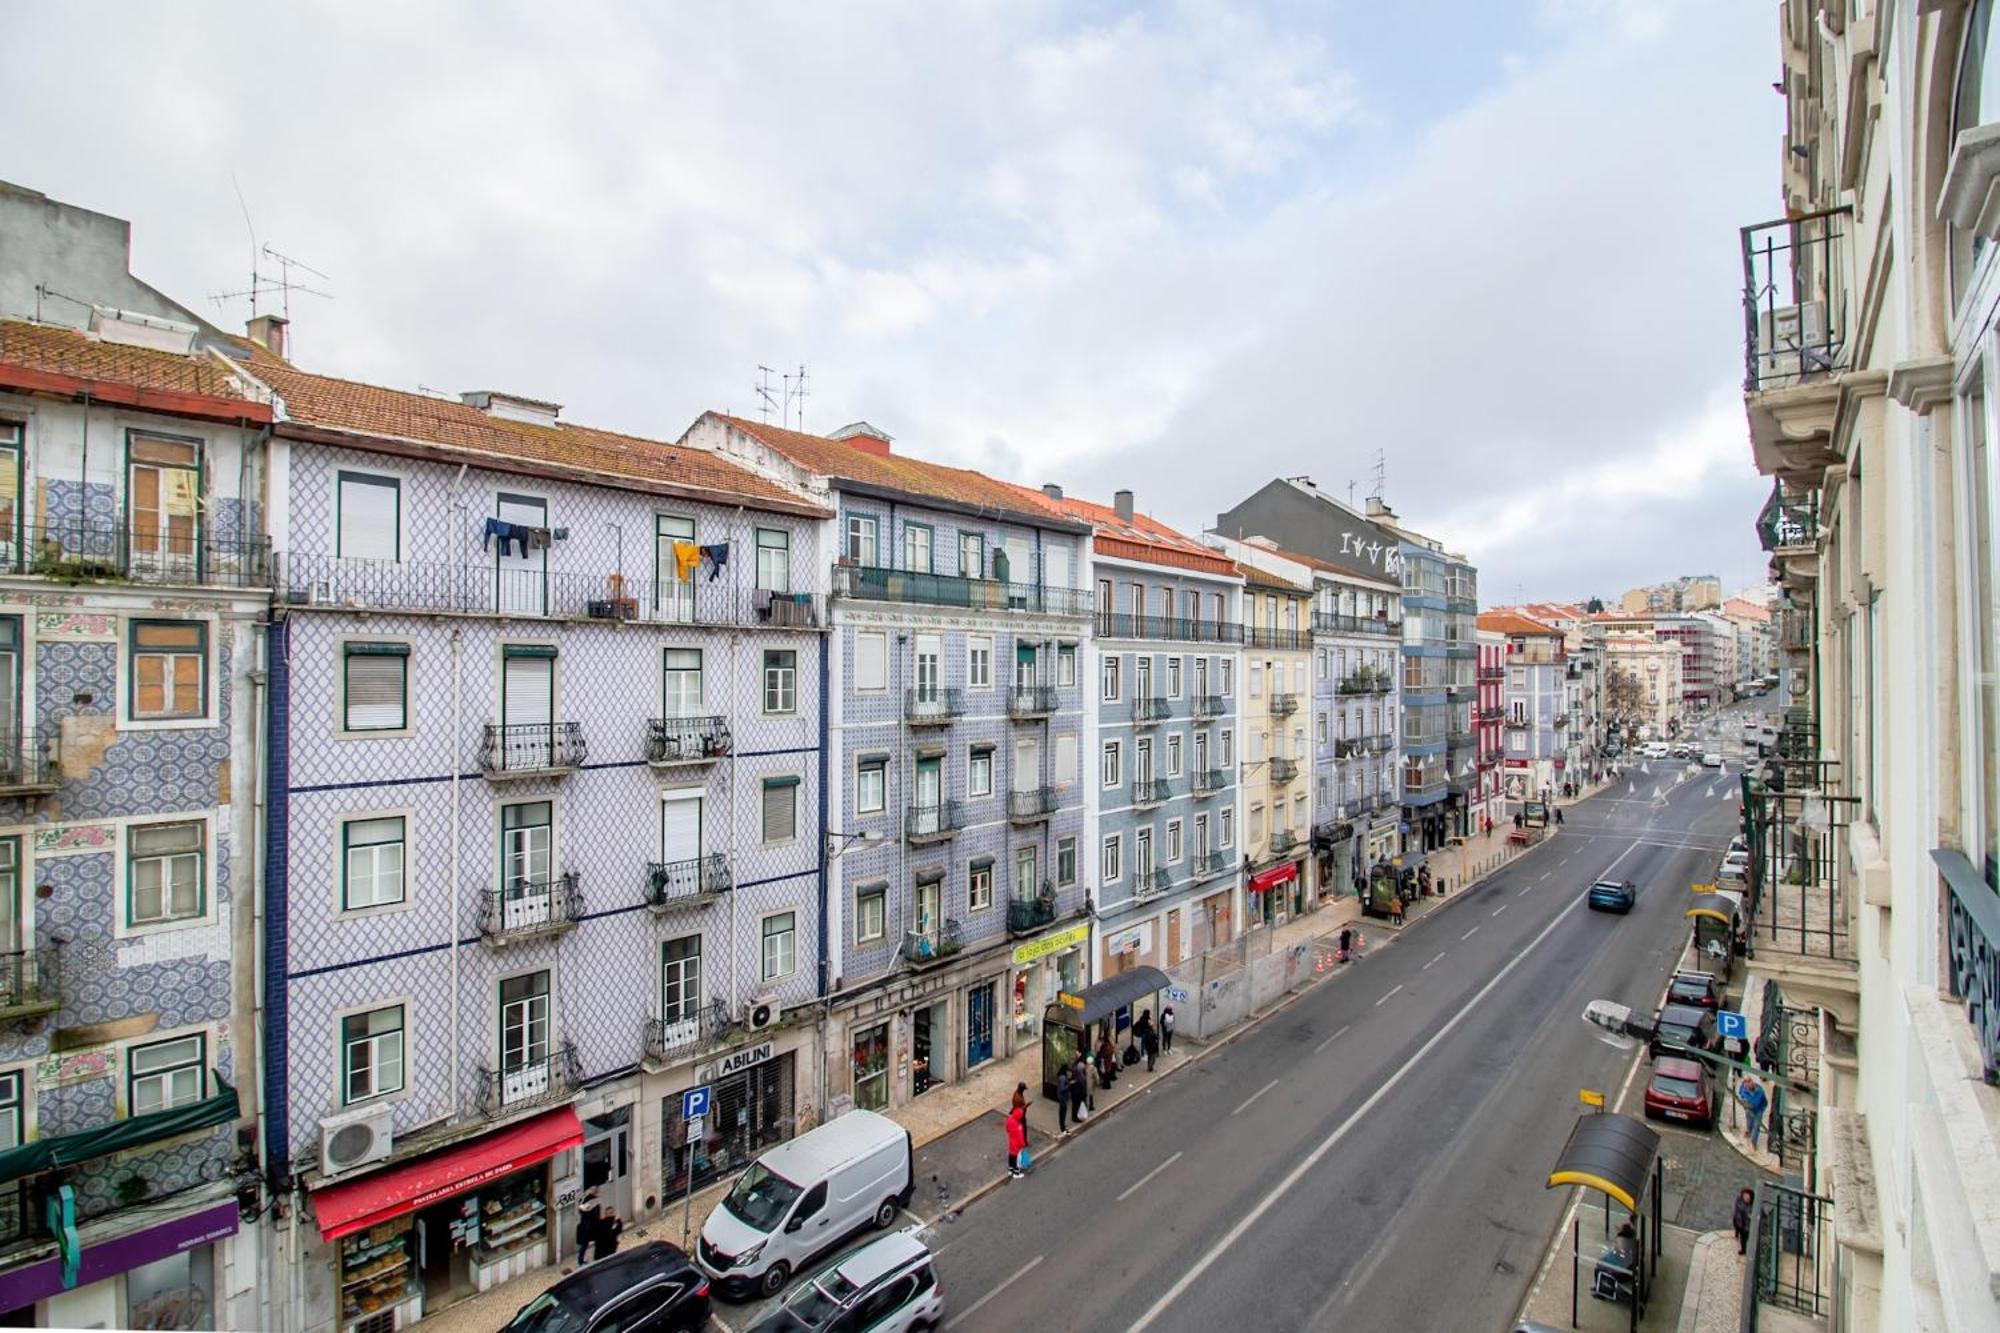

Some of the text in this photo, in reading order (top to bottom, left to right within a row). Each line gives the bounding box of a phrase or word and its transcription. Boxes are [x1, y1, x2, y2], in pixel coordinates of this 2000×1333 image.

[1723, 1015, 1740, 1033] P
[722, 1044, 770, 1074] ABILINI
[688, 1092, 704, 1115] P
[455, 1174, 484, 1189] ESTRELA
